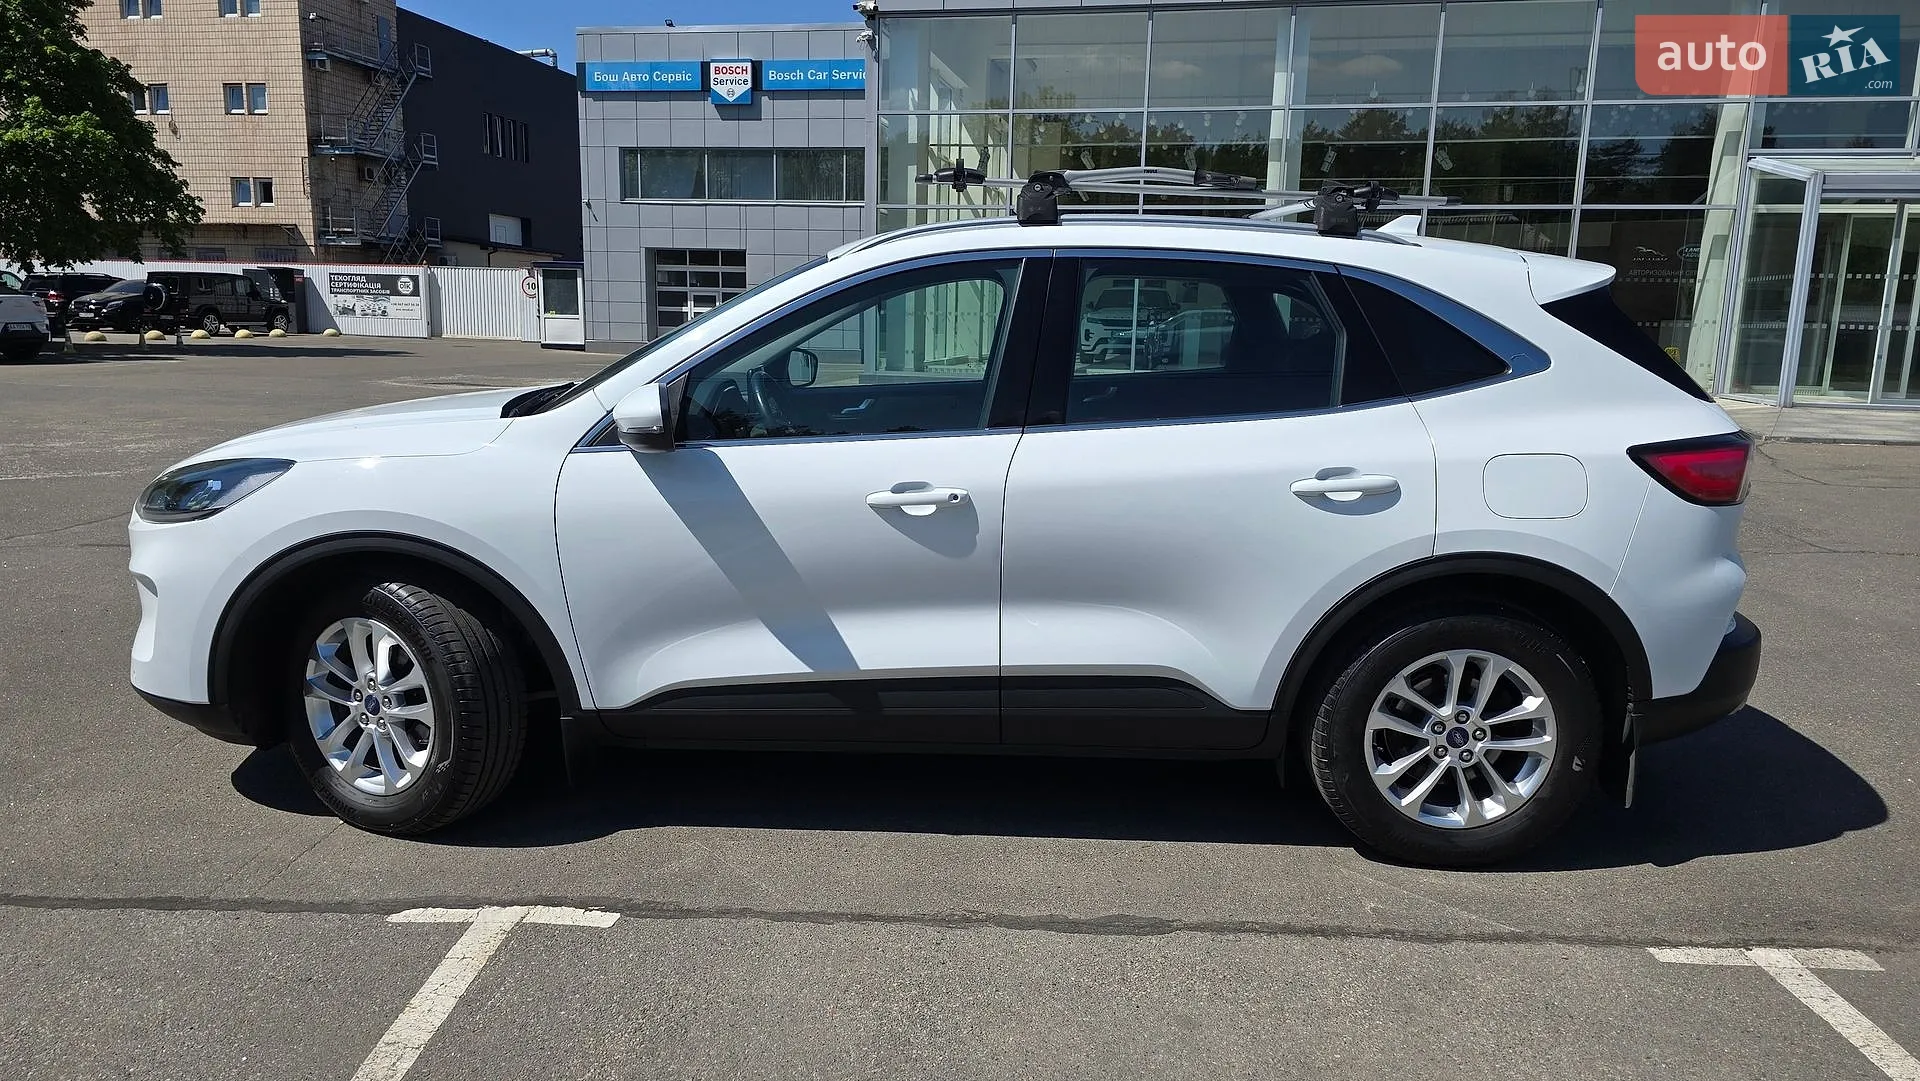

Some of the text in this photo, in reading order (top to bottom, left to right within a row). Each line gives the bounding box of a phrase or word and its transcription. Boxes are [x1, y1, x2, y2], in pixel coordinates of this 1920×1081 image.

[714, 65, 748, 75] BOSCH
[768, 69, 804, 81] Bosch
[807, 69, 828, 80] Car
[594, 70, 692, 84] Бош Авто Сервіс
[713, 76, 749, 86] Service
[330, 274, 367, 283] ТЕХОГЛЯД
[330, 281, 382, 290] СЕРТИФІКАЦІЯ
[526, 282, 536, 290] 10
